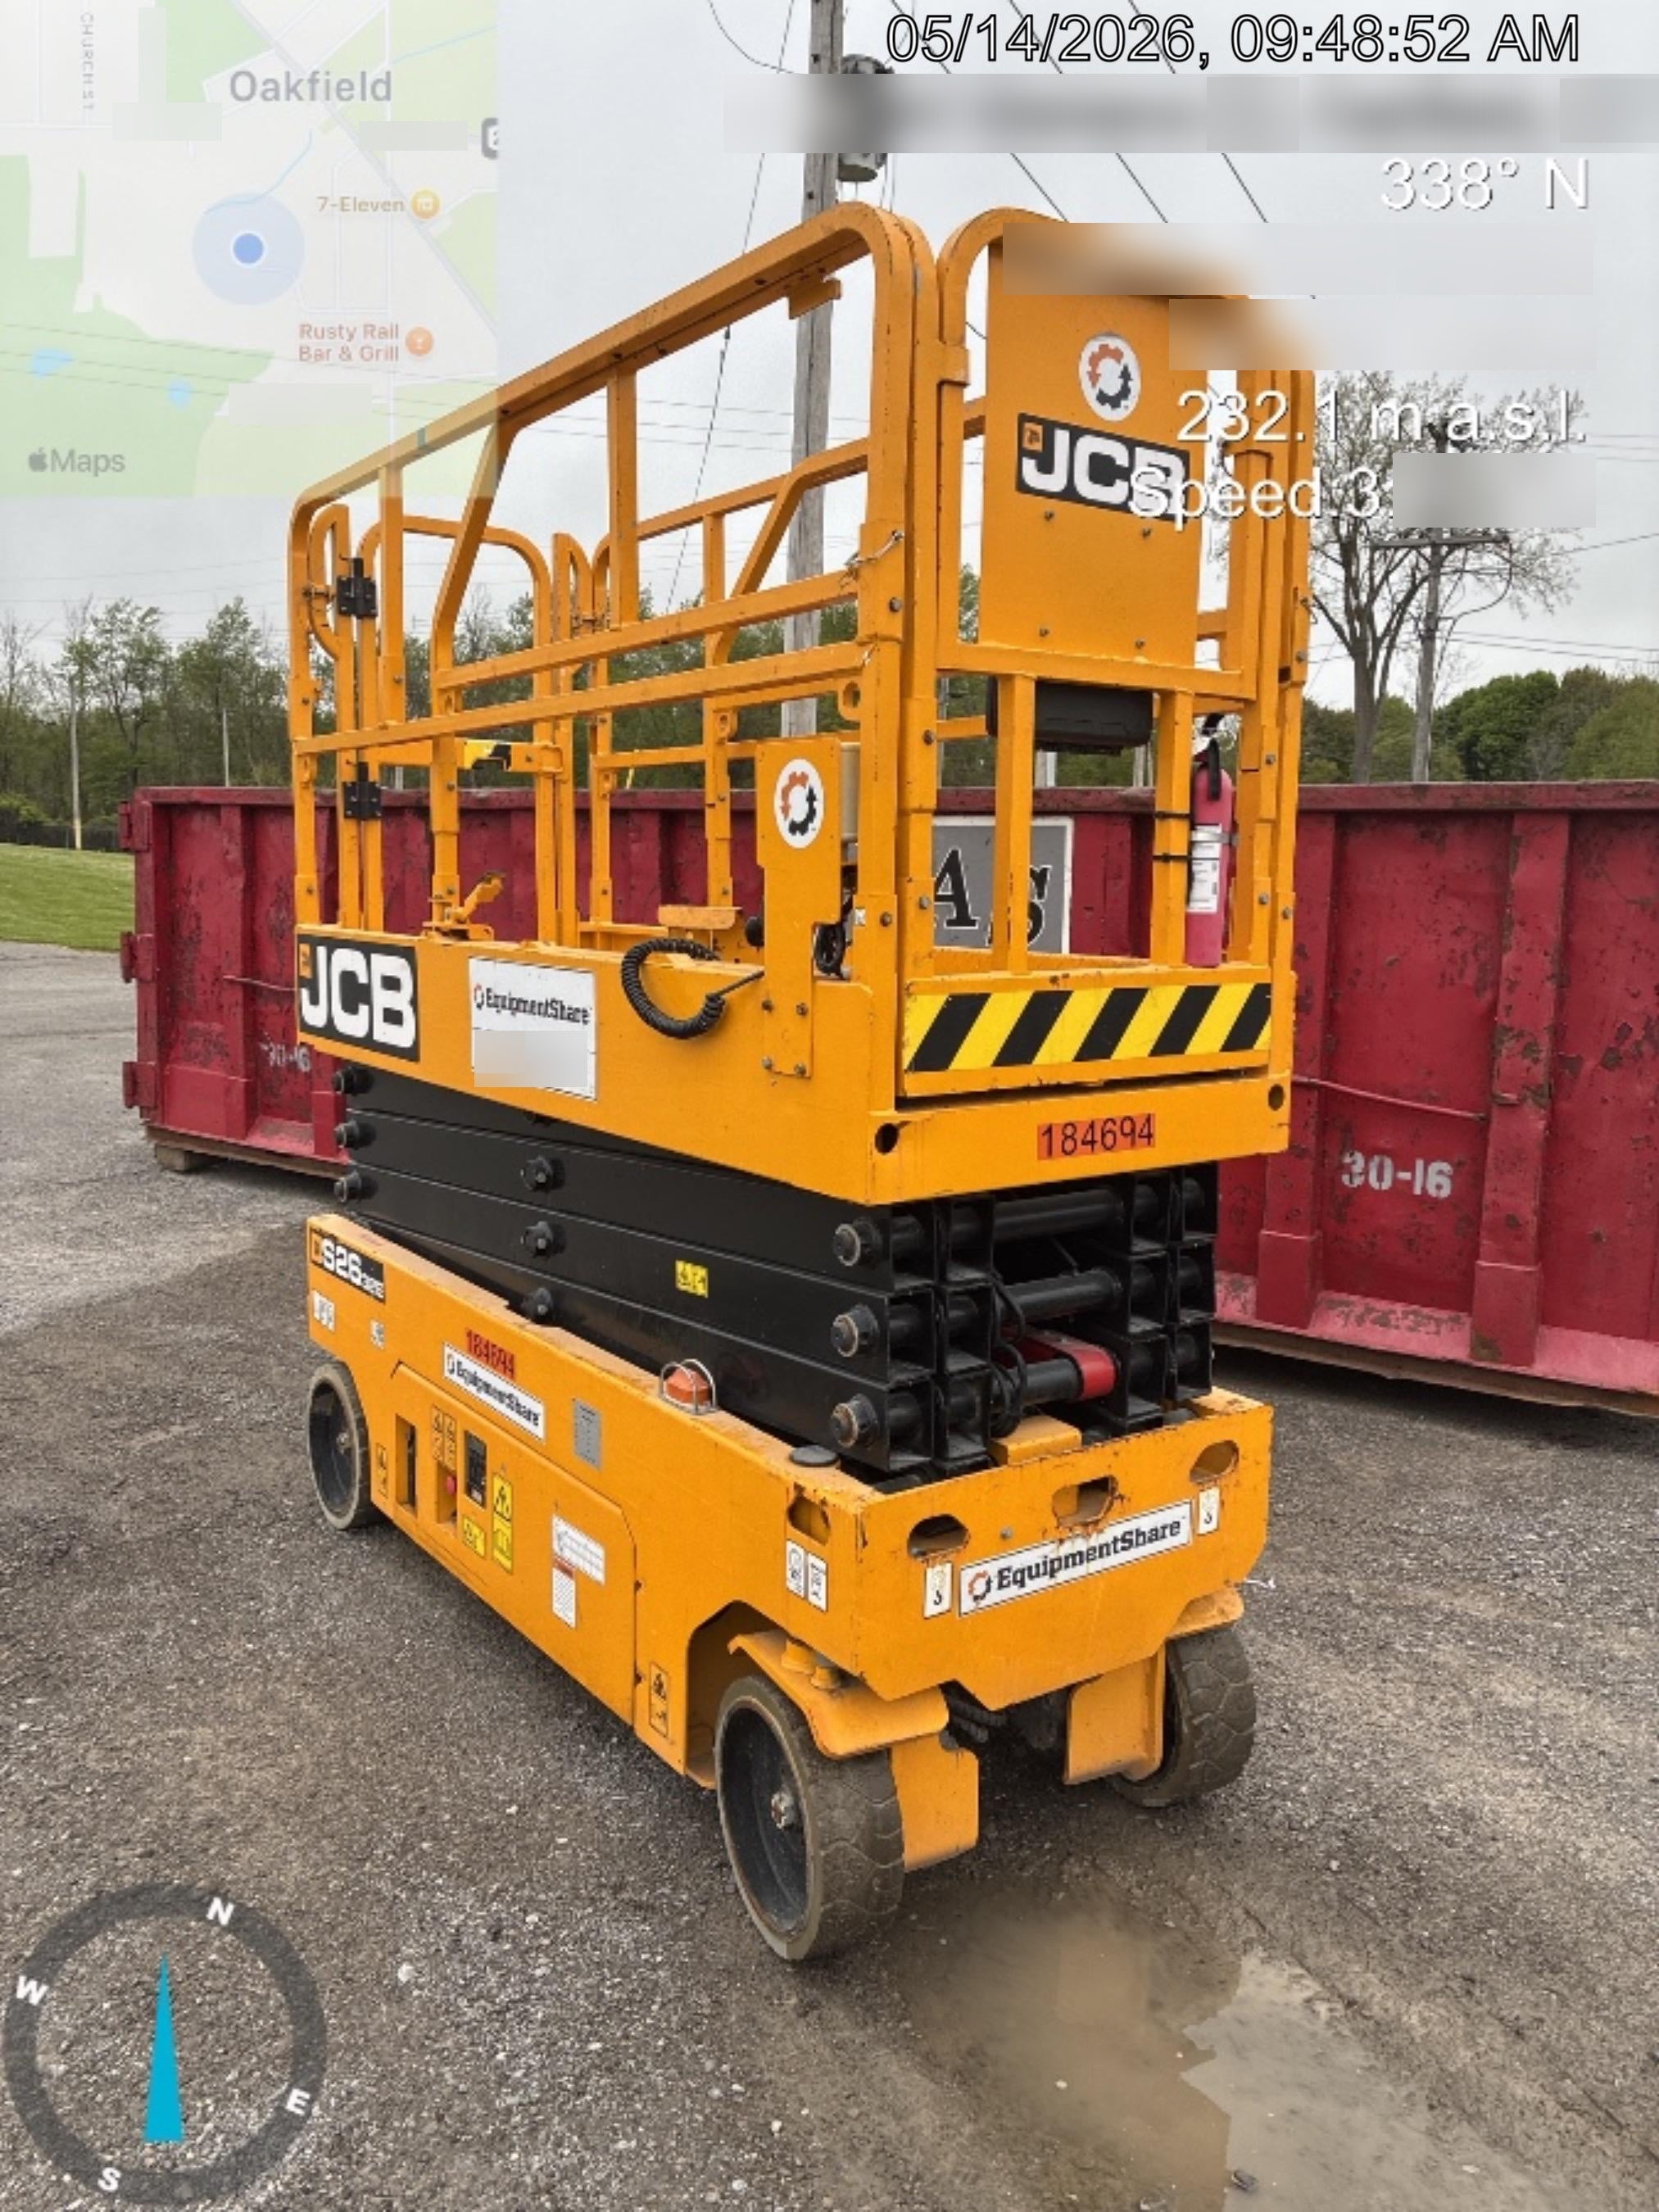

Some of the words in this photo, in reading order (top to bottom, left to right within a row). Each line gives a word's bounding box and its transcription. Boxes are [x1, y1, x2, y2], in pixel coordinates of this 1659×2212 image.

[1022, 428, 1186, 523] JCB
[300, 945, 416, 1049] JCB
[486, 986, 589, 1026] EquipmentShare
[1041, 1113, 1154, 1158] 184694
[1341, 1149, 1453, 1199] 30-16
[456, 1359, 541, 1427] EquipmentShare
[996, 1520, 1181, 1590] EquipmentShare
